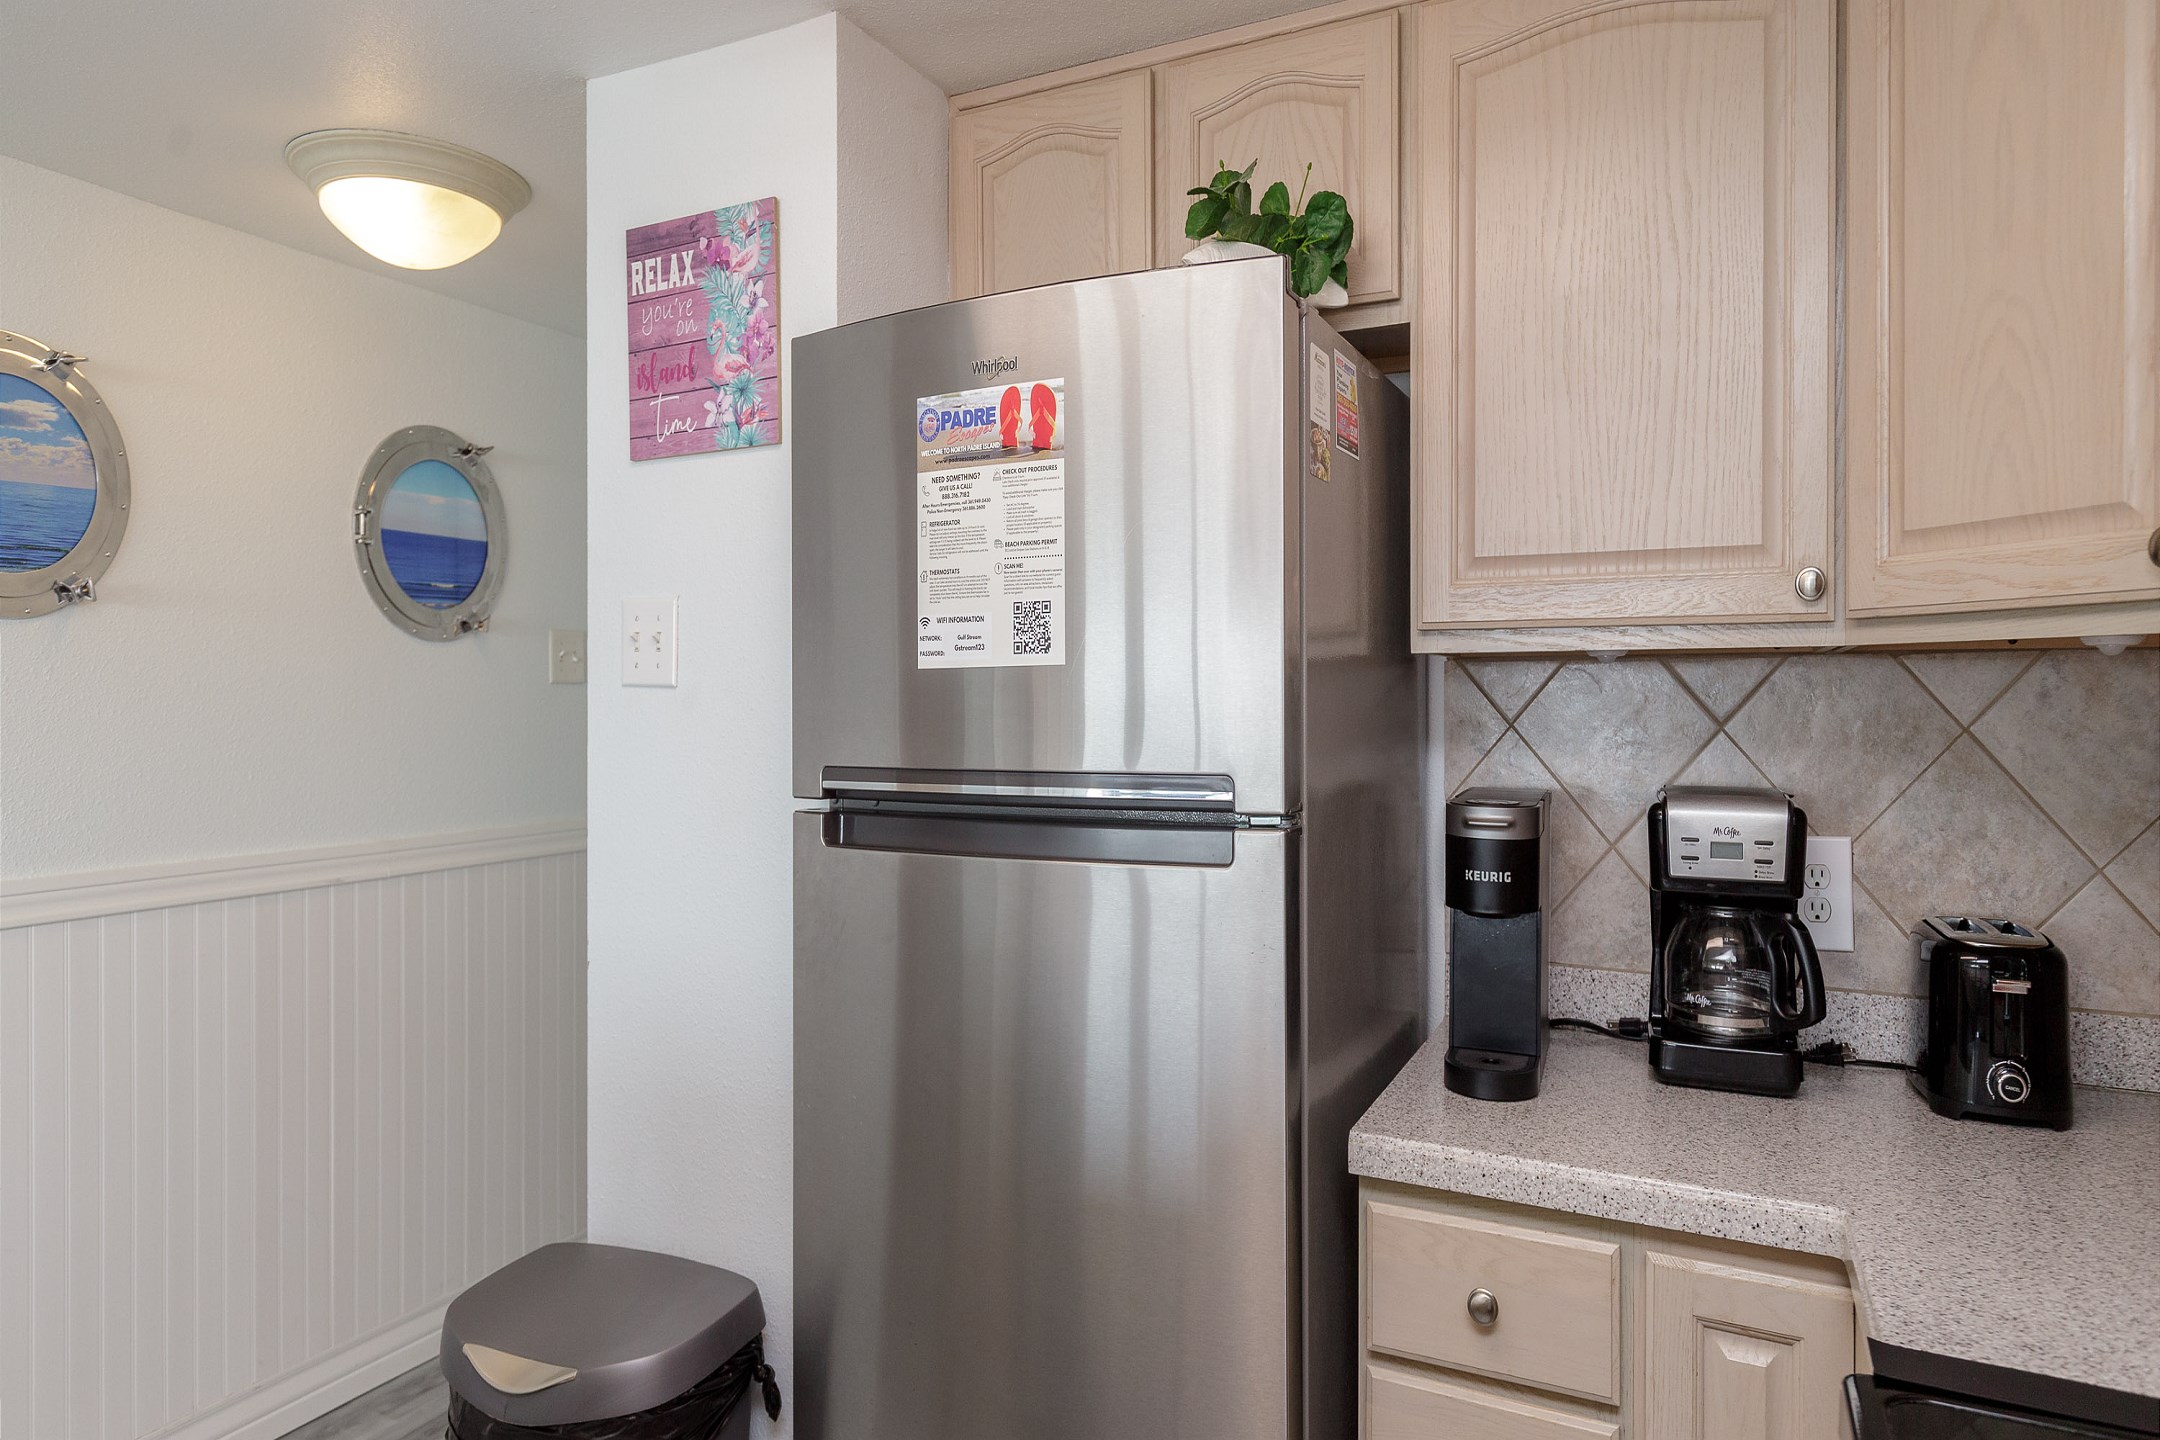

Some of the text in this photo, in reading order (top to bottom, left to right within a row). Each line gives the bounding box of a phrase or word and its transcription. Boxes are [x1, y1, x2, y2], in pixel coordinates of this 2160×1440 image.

[630, 249, 695, 296] RELAX
[641, 298, 693, 336] you're
[676, 316, 698, 337] on
[636, 345, 696, 394] island
[971, 355, 1018, 380] Whirlpool
[940, 406, 997, 431] PADRE
[944, 422, 995, 446] Escapes
[920, 448, 943, 457] WELCOME
[951, 445, 967, 454] NORTH
[967, 444, 983, 452] PADRE
[983, 441, 1000, 450] ISLAND
[1028, 464, 1058, 473] PROCEDURES
[931, 472, 981, 485] NEED SOMETHING?
[929, 519, 961, 528] REFRIGERATOR
[929, 568, 960, 576] THERMOSTATS
[948, 615, 985, 623] INFORMATION
[954, 643, 985, 652] Gstream123
[1723, 826, 1741, 839] Coffee
[1465, 869, 1512, 883] KEURIG
